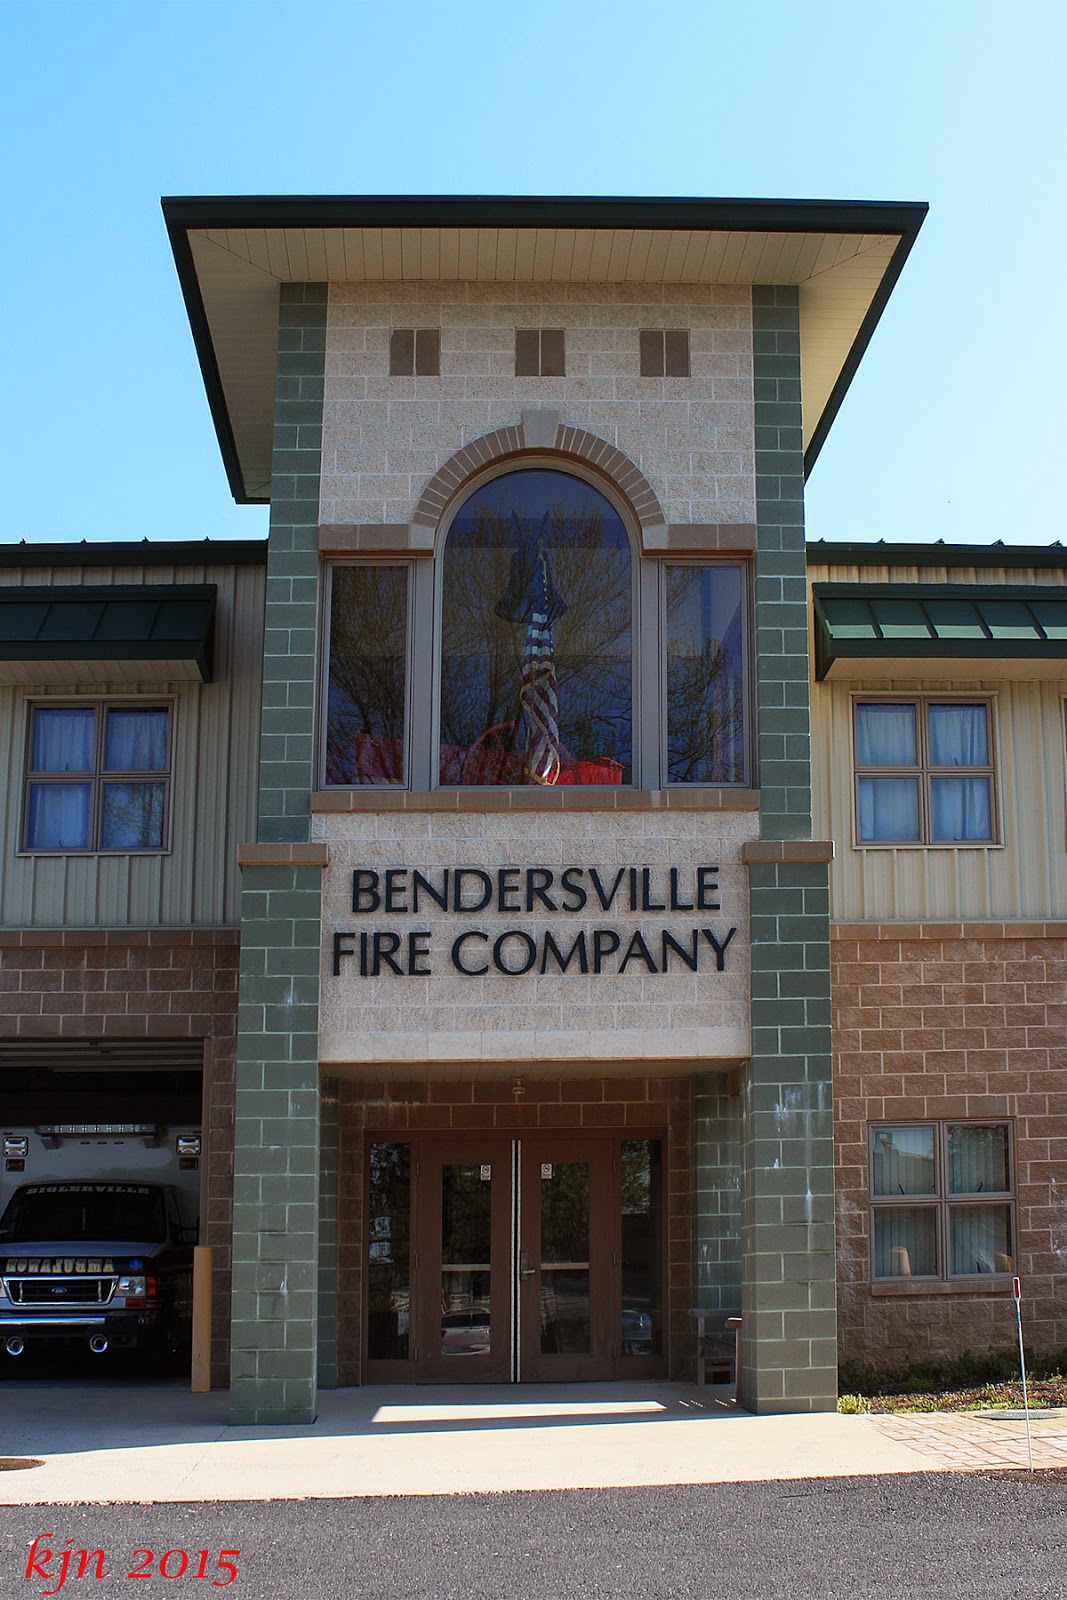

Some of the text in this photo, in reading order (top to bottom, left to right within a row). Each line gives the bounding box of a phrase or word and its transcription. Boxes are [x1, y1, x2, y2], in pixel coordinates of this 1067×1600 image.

[351, 867, 721, 913] BENDERSVILLE
[333, 927, 737, 976] FIRE COMPANY
[26, 1186, 150, 1195] BIGLERVILLE
